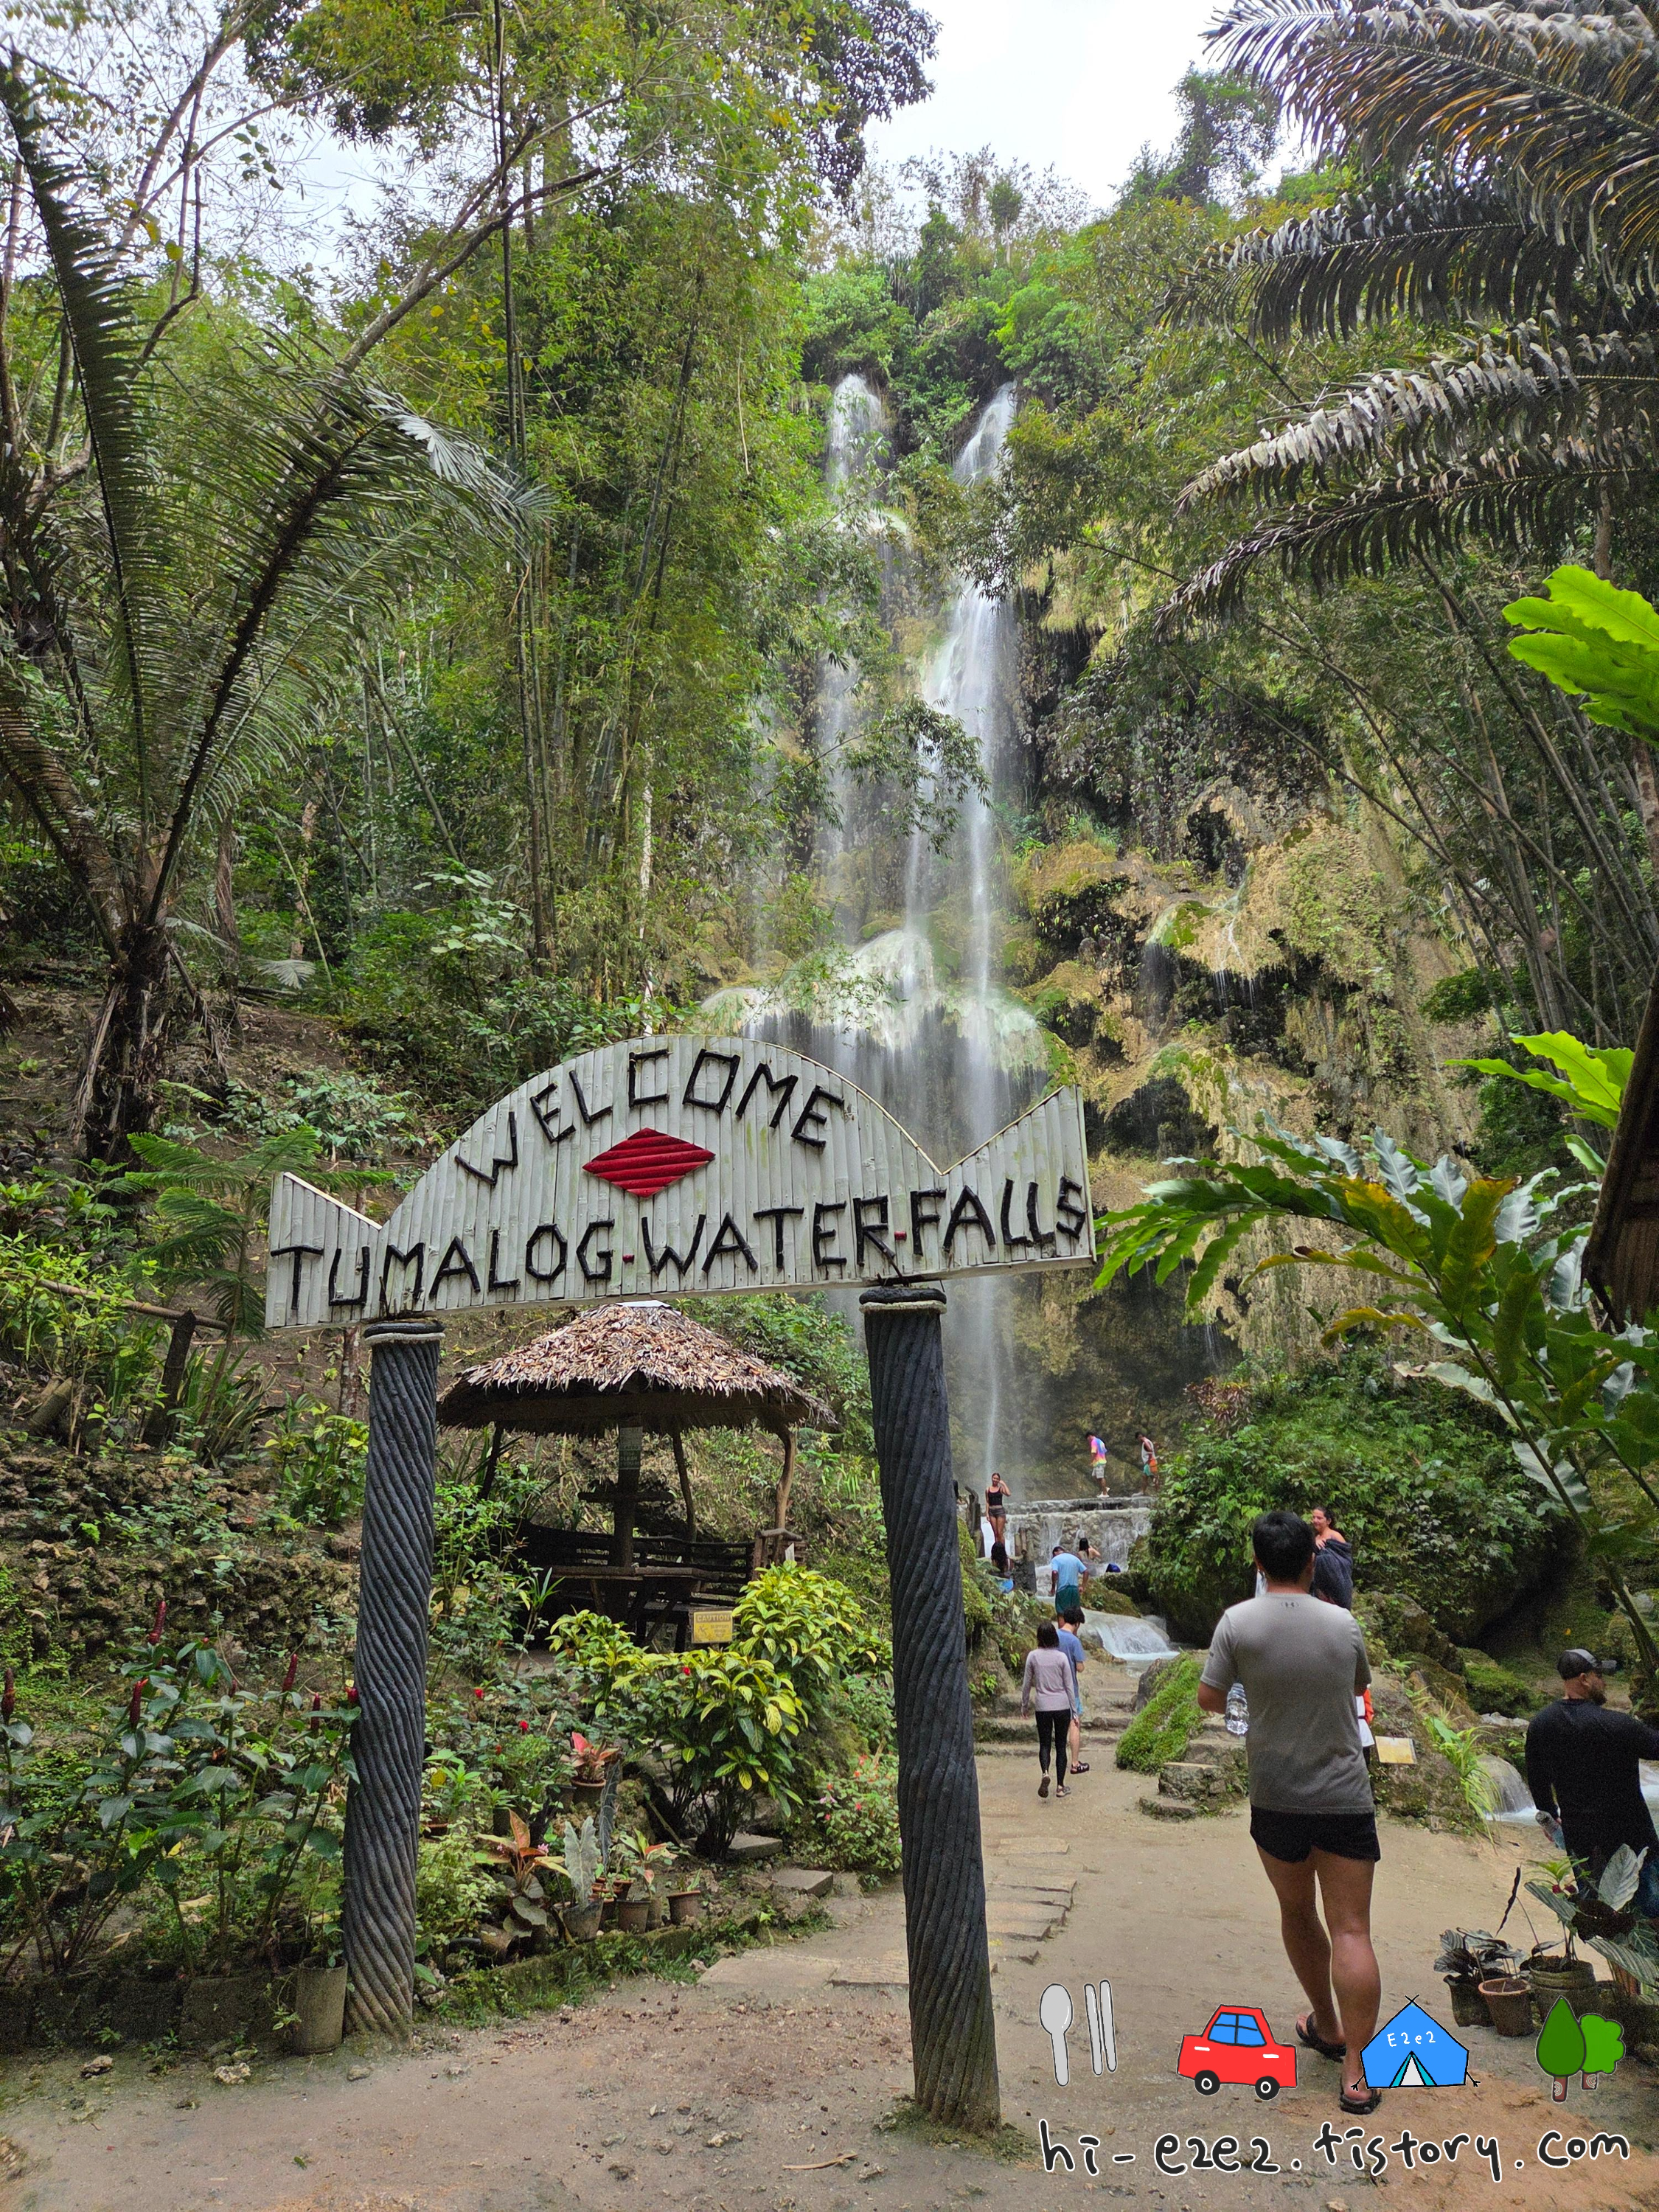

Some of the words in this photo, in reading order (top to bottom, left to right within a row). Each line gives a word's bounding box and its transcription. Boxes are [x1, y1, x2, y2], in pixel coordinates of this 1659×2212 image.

[454, 1048, 845, 1185] WELCOME
[270, 1218, 616, 1310] TUMALOG
[641, 1195, 897, 1277] WATER
[910, 1175, 1087, 1256] FALLS
